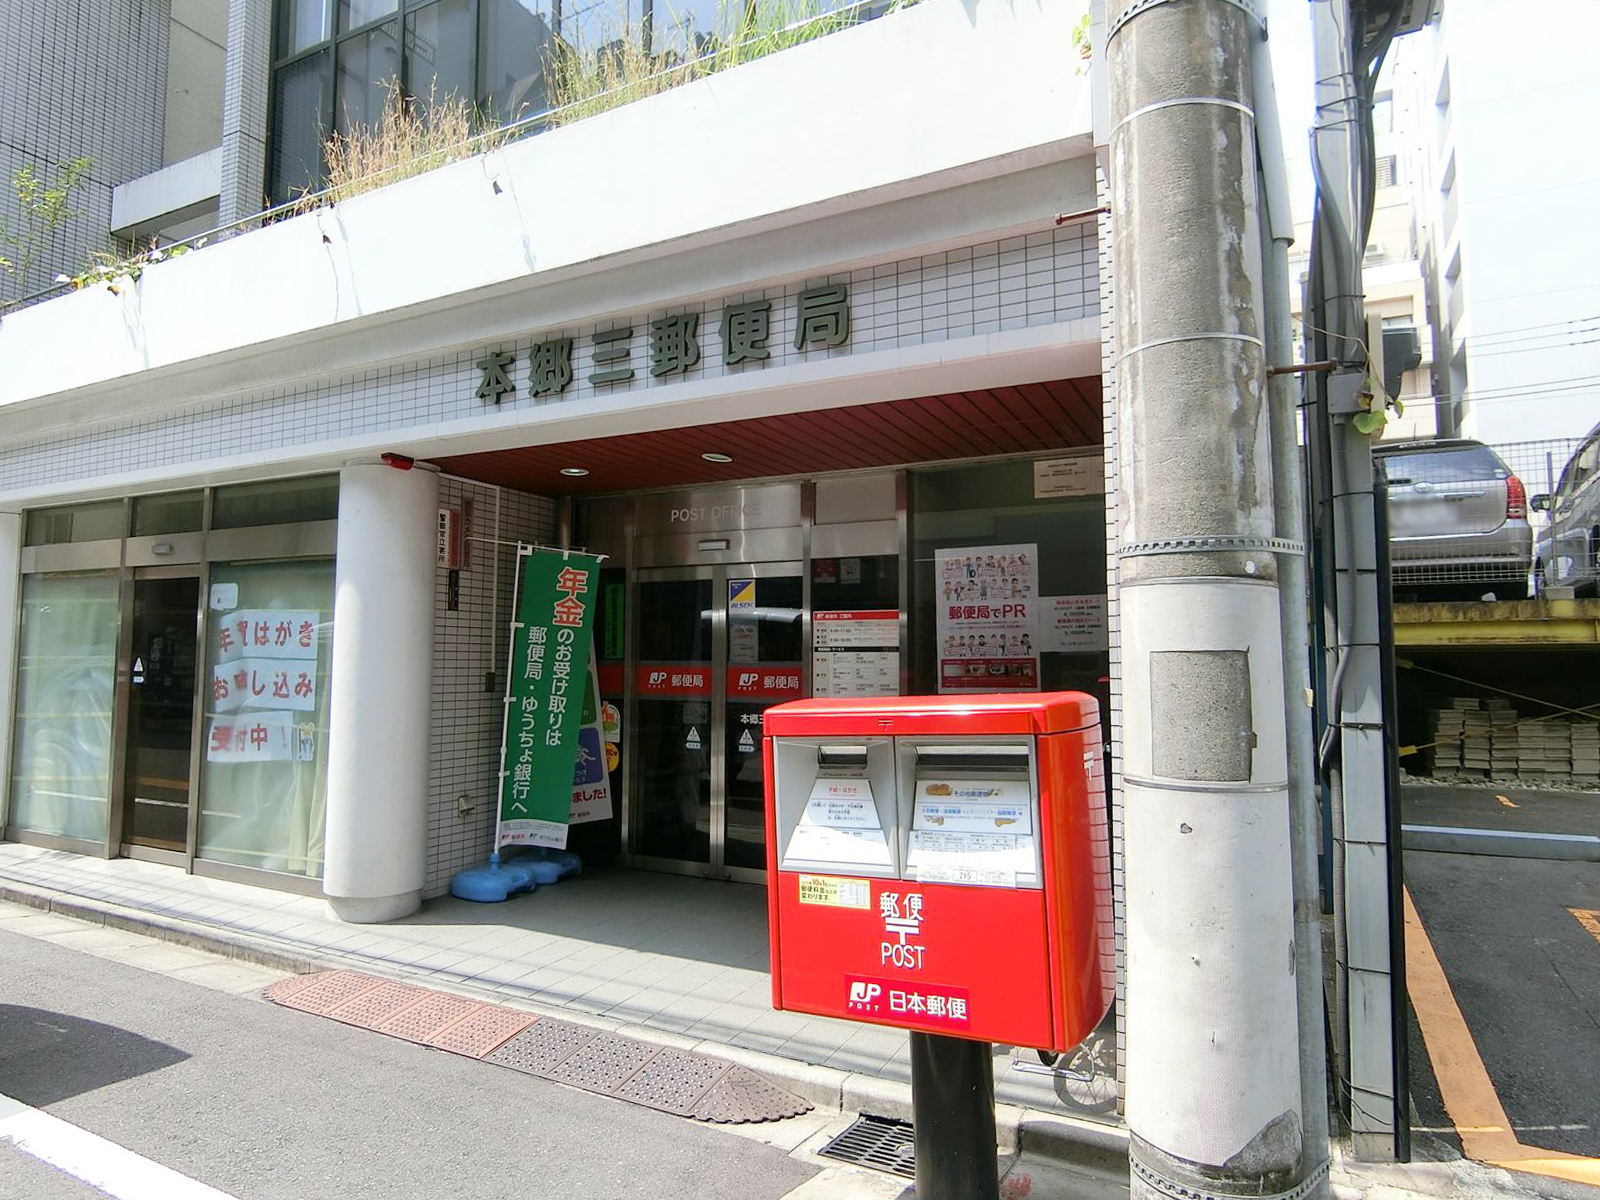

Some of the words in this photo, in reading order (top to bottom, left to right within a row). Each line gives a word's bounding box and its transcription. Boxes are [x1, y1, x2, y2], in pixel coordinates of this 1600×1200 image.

[475, 284, 850, 404] 本郷三郵便局
[671, 508, 707, 522] POST
[949, 603, 1026, 620] 郵便局でPR
[546, 566, 589, 746] 年金のお受け取りは
[671, 674, 704, 688] 郵便局
[764, 675, 799, 690] 郵便局
[511, 626, 548, 813] 郵便局・ゆうちょ銀行へ
[880, 891, 924, 921] 郵便
[881, 942, 925, 970] POST
[848, 1001, 880, 1012] POST
[889, 990, 968, 1019] 日本郵便
